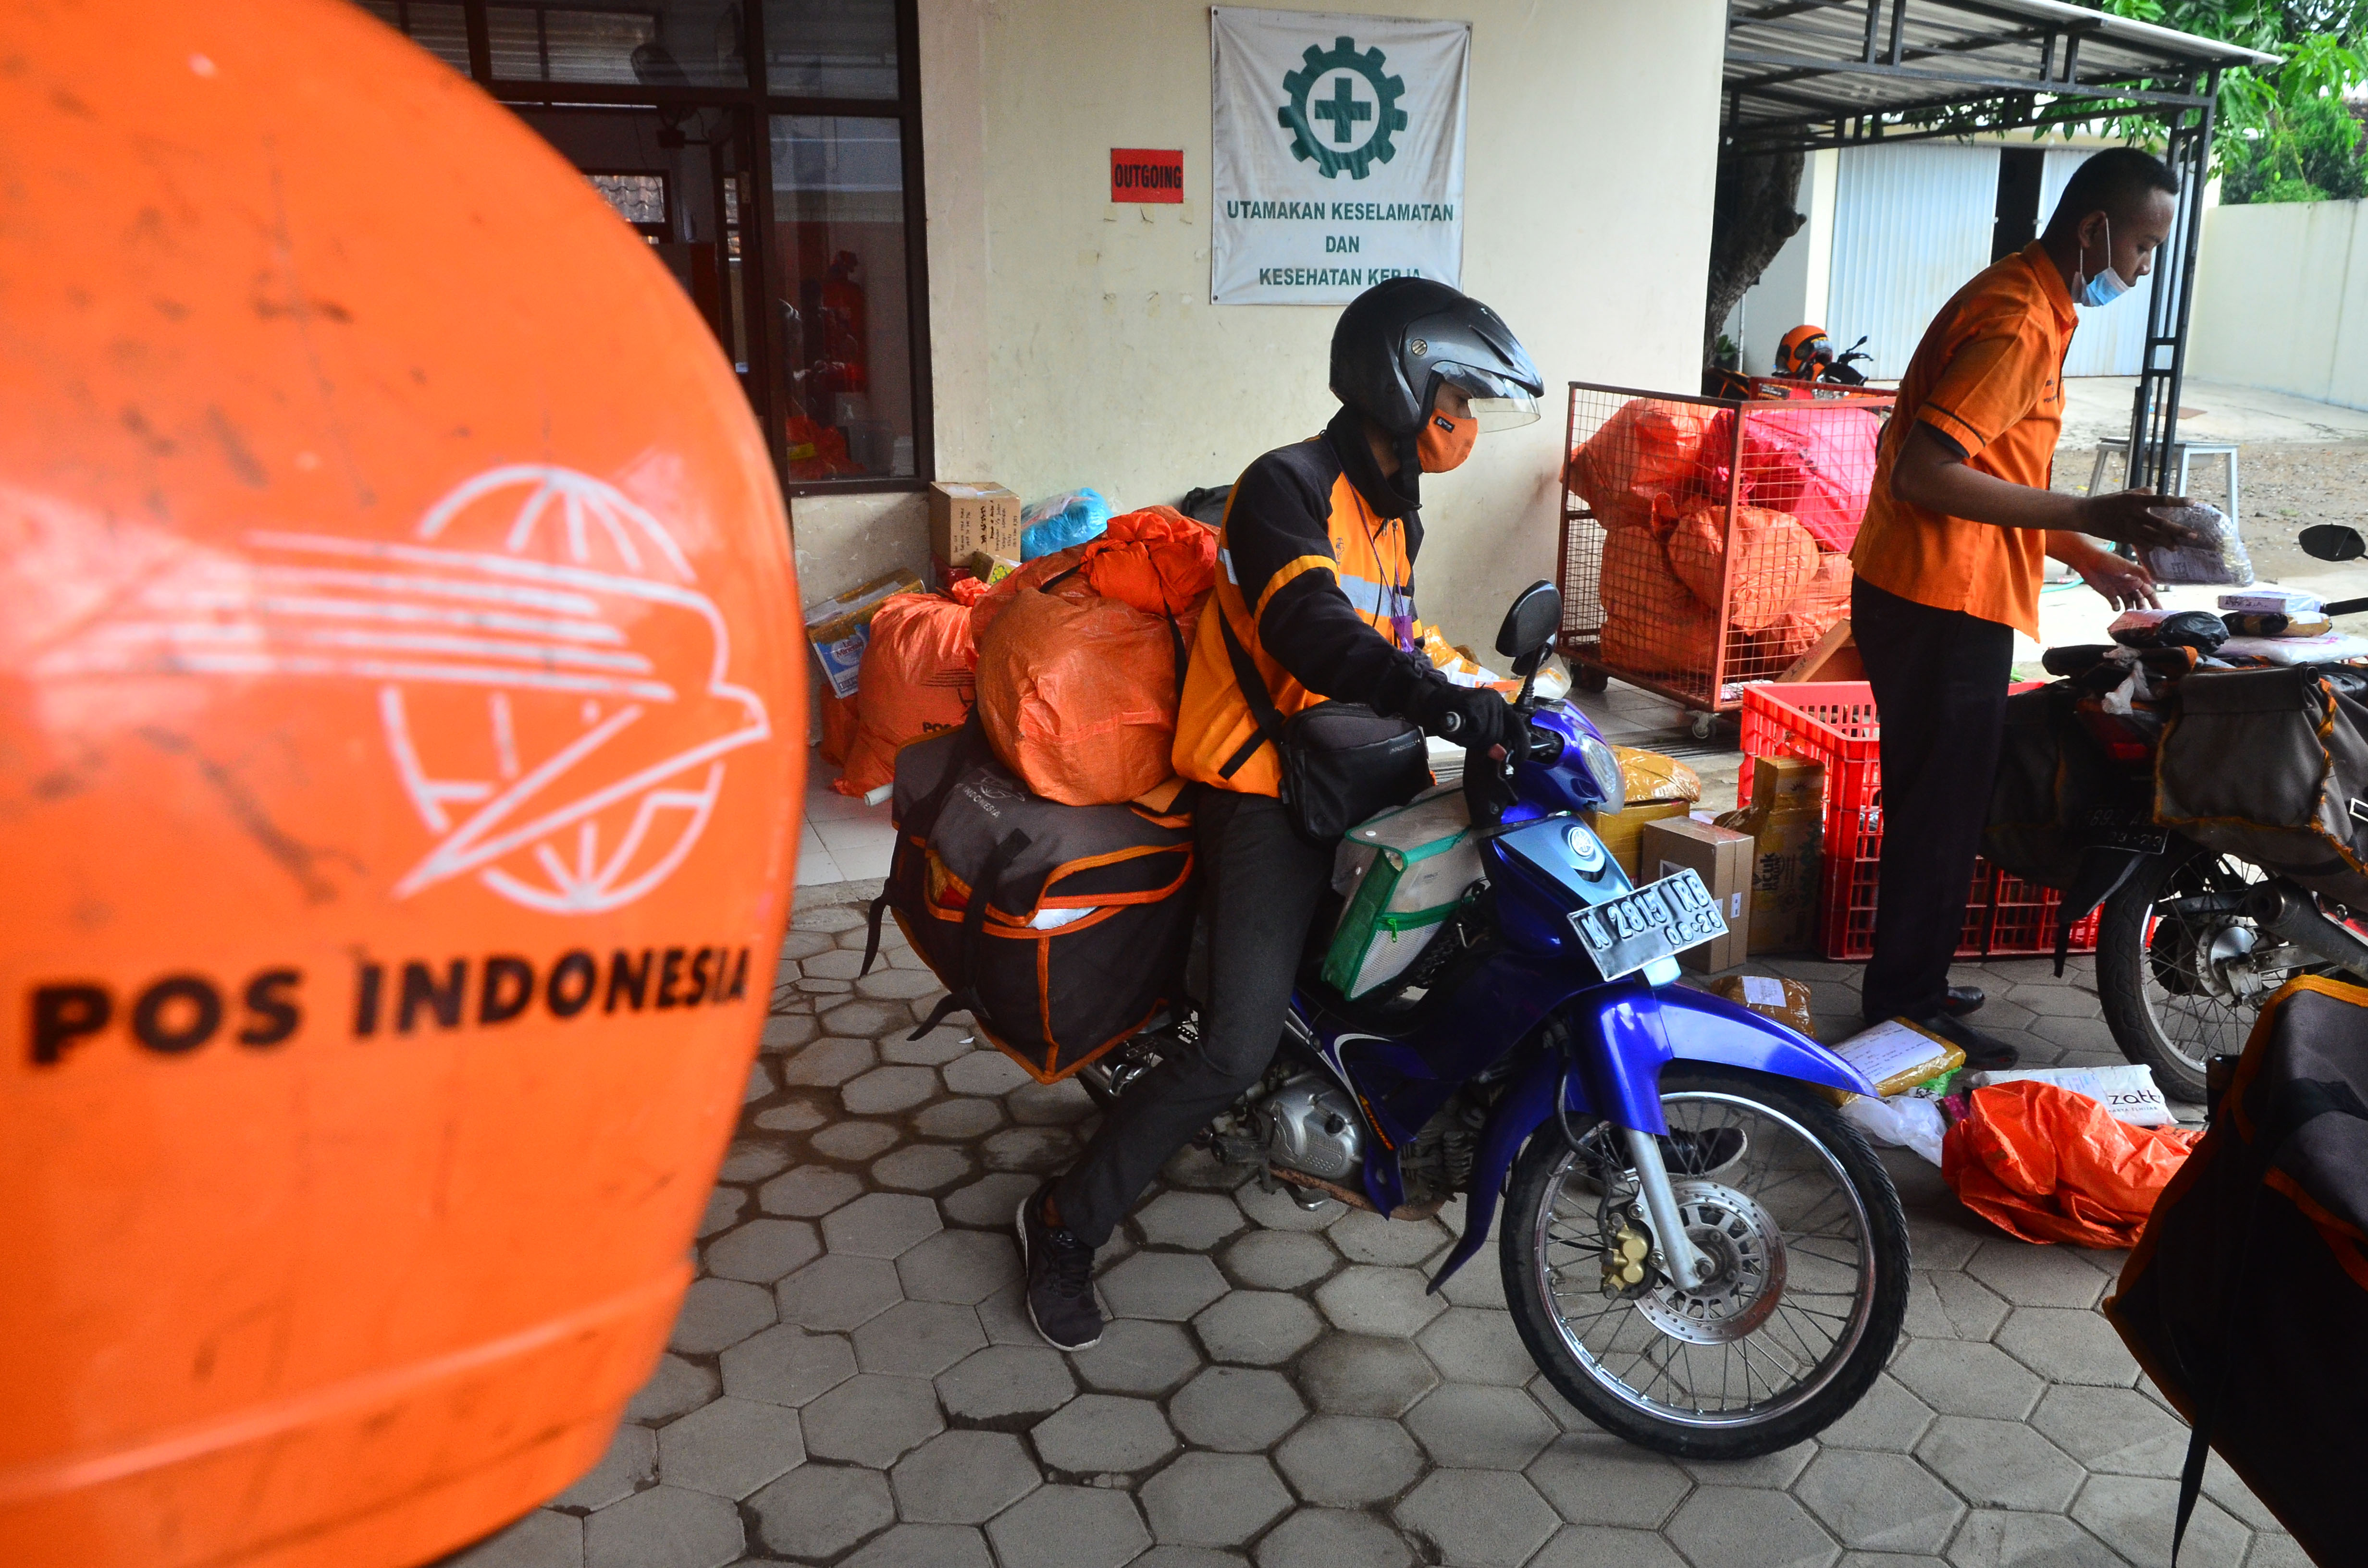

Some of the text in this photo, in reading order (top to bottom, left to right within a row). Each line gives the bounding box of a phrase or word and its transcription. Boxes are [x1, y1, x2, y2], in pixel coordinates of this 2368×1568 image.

[1114, 163, 1182, 189] OUTGOING
[1227, 200, 1454, 221] UTAMAKAN KESELAMATAN
[1325, 235, 1360, 253] DAN
[1259, 268, 1362, 285] KESEHATAN
[1581, 875, 1710, 949] K 2815 RB
[25, 947, 751, 1070] POS INDONESIA
